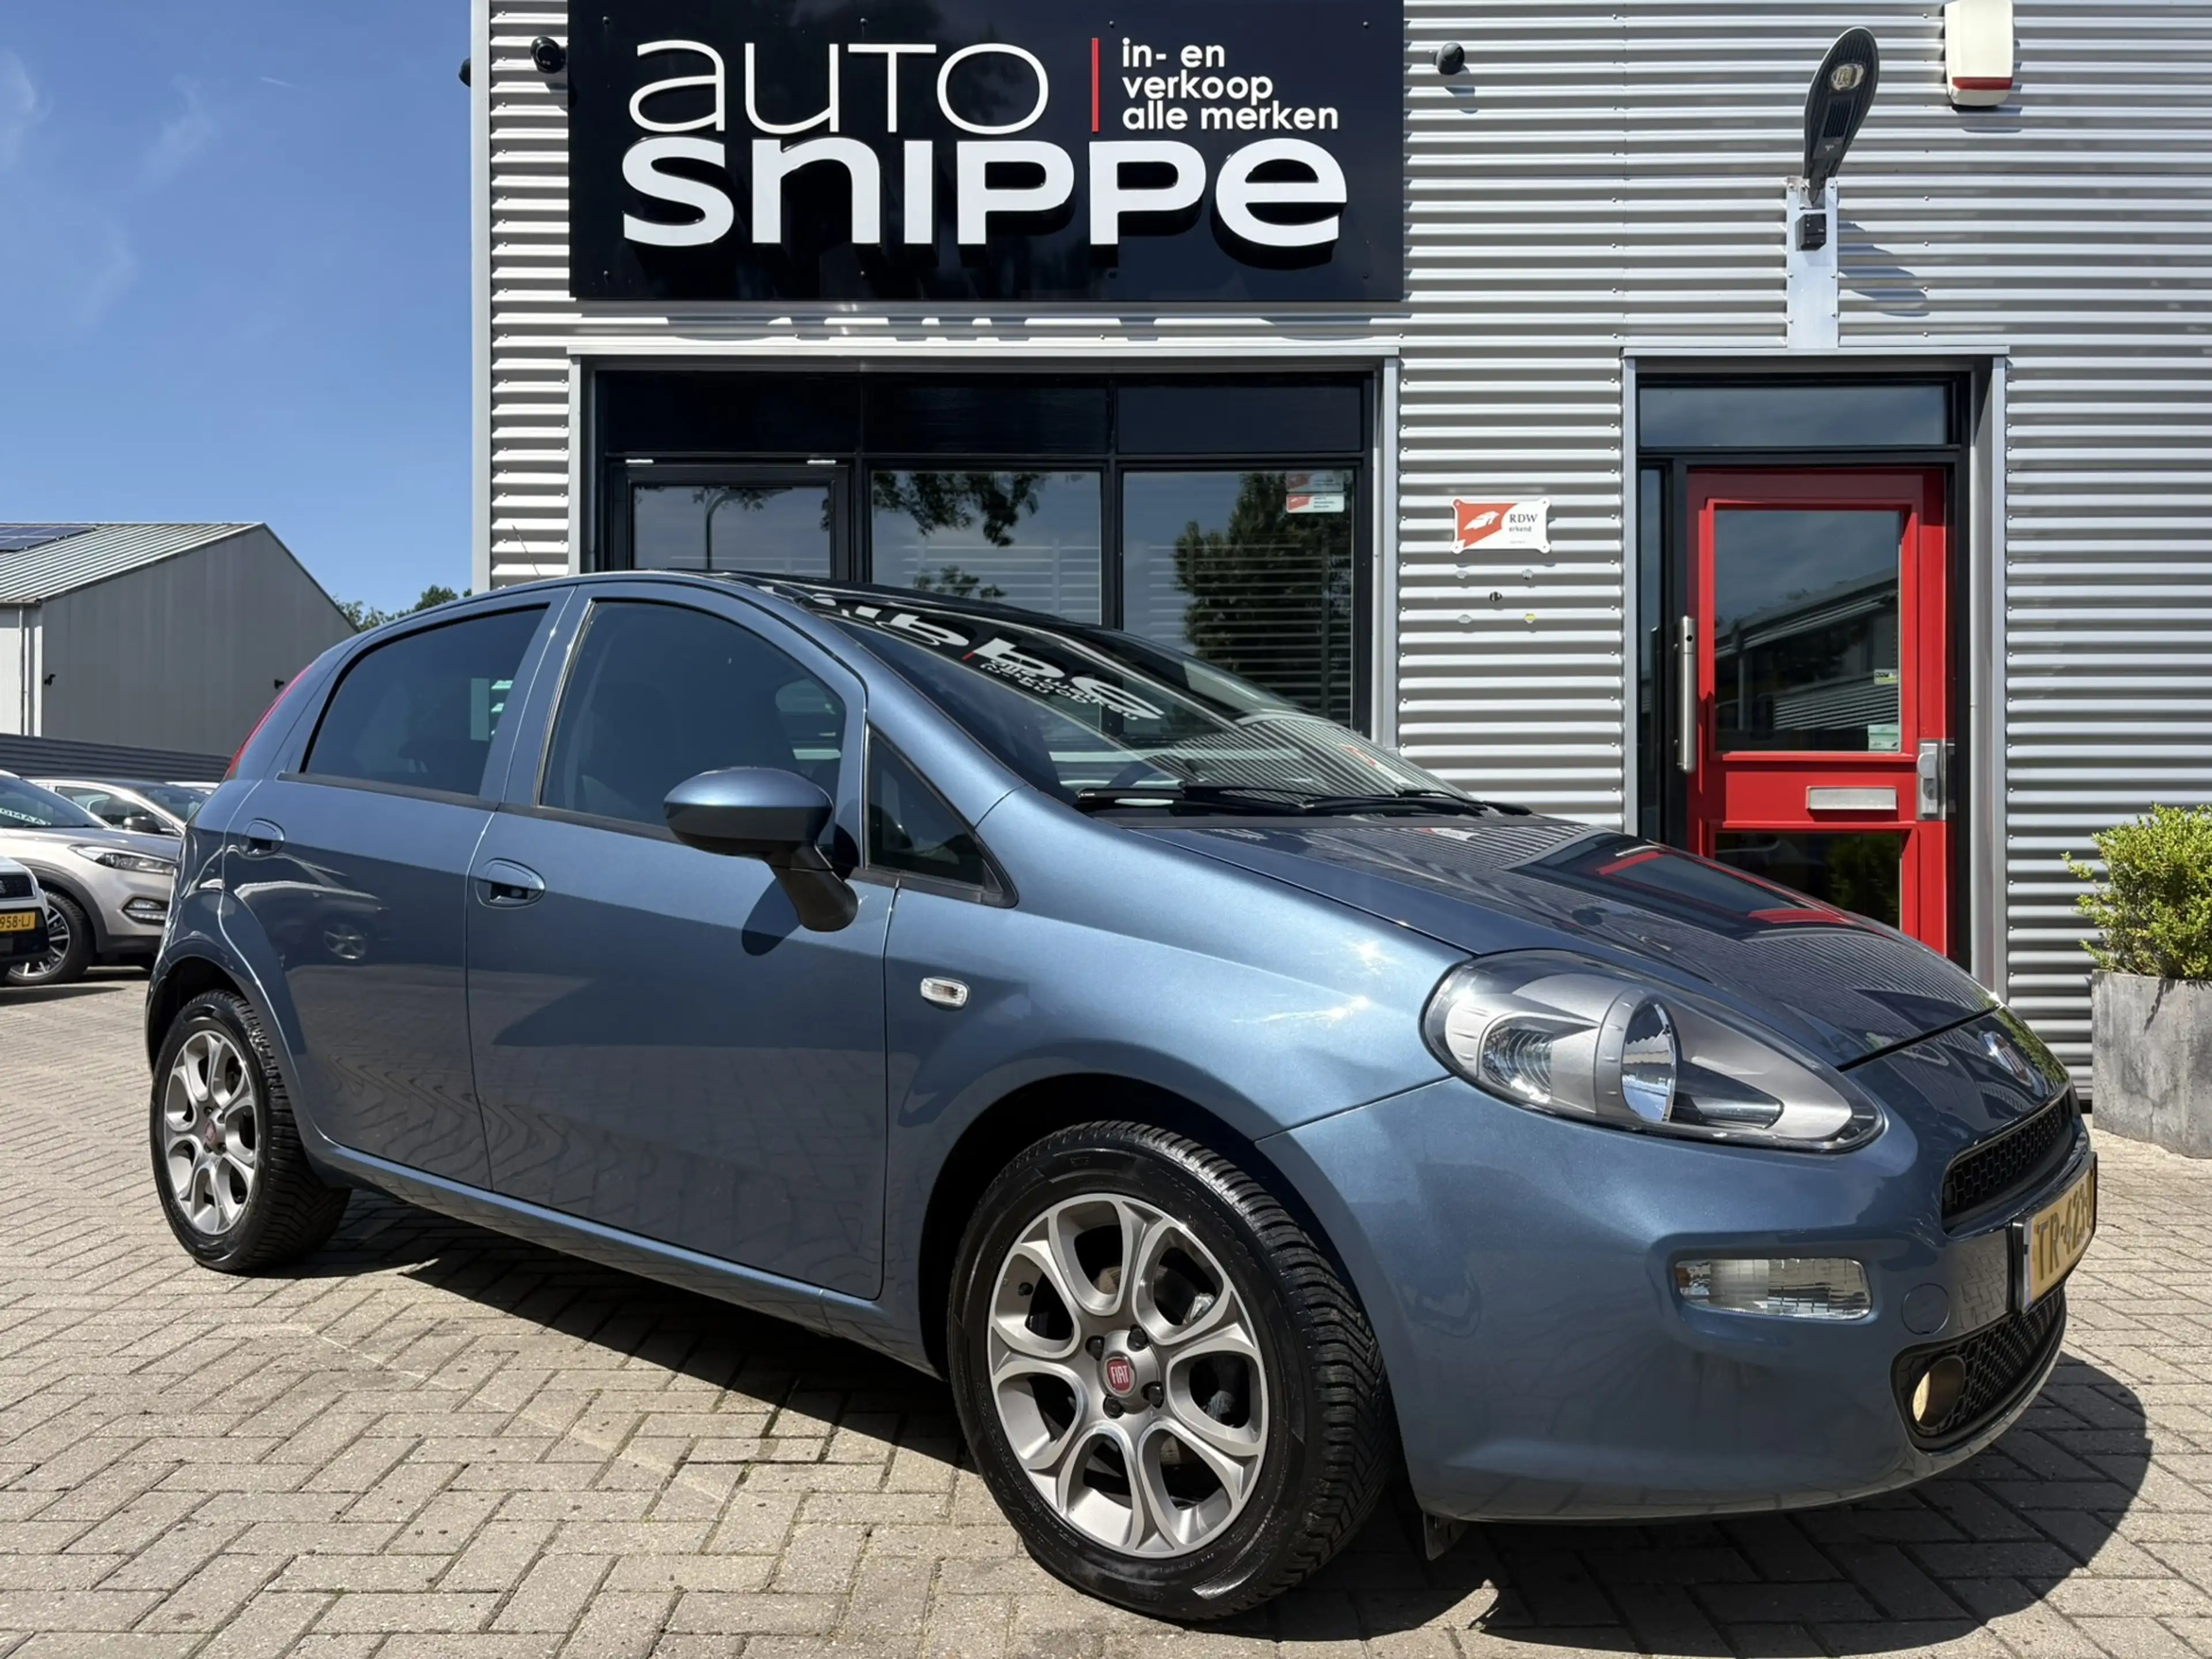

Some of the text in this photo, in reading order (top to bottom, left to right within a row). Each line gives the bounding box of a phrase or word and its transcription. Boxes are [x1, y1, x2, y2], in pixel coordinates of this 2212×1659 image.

[1123, 37, 1225, 67] in- en
[1122, 69, 1274, 105] verkoop
[1123, 100, 1338, 130] alle merken
[1509, 514, 1538, 523] RDW
[1111, 1365, 1129, 1384] FIAT
